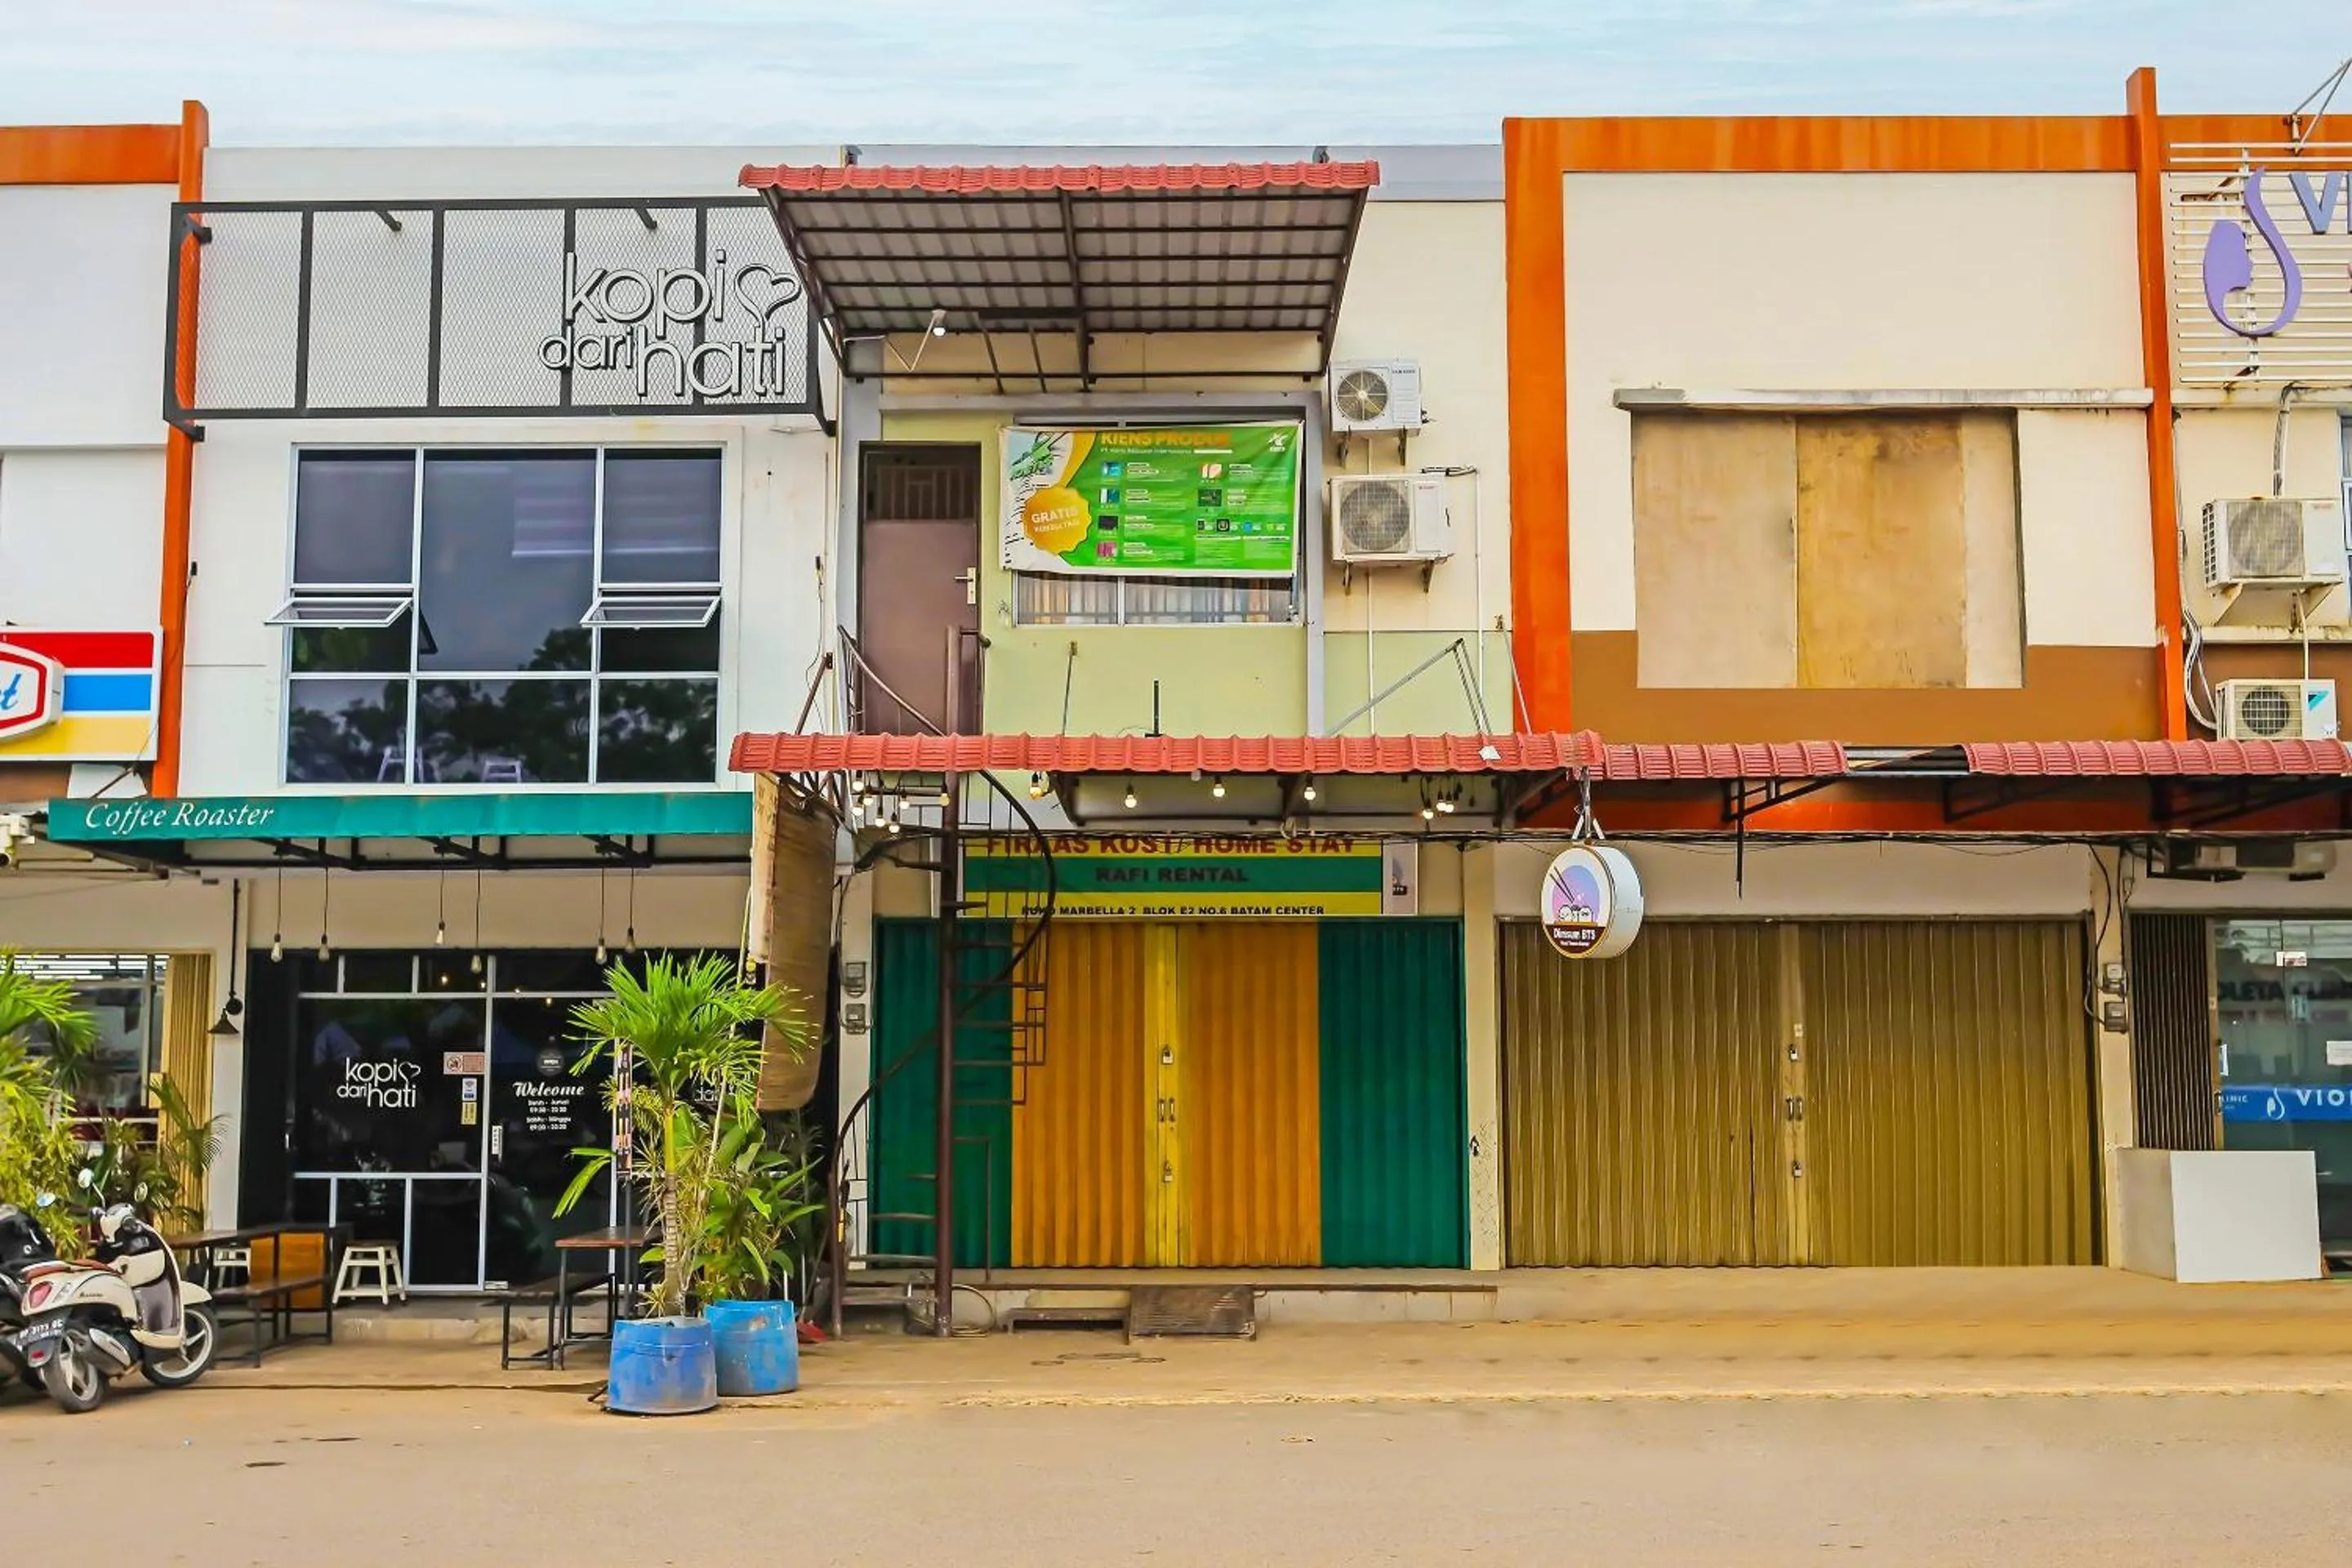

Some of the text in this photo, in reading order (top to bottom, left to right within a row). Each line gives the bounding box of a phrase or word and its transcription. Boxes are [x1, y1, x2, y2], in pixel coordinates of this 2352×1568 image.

[2289, 172, 2352, 235] V
[564, 249, 726, 339] kopi
[538, 325, 786, 396] dari hati
[85, 801, 274, 835] Coffee Roaster
[1193, 837, 1276, 853] HOME
[1287, 836, 1354, 853] STAY
[1095, 867, 1250, 882] RAFI RENTAL
[1059, 906, 1125, 915] MARBELLA
[1127, 906, 1137, 915] 2
[1143, 906, 1175, 915] BLOK
[1231, 906, 1272, 915] BATAM
[1276, 906, 1325, 915] CENTER
[346, 1057, 398, 1087] kopi
[336, 1082, 416, 1108] dari hati
[512, 1081, 585, 1097] Welcome
[2221, 1089, 2352, 1107] LINIC VIO
